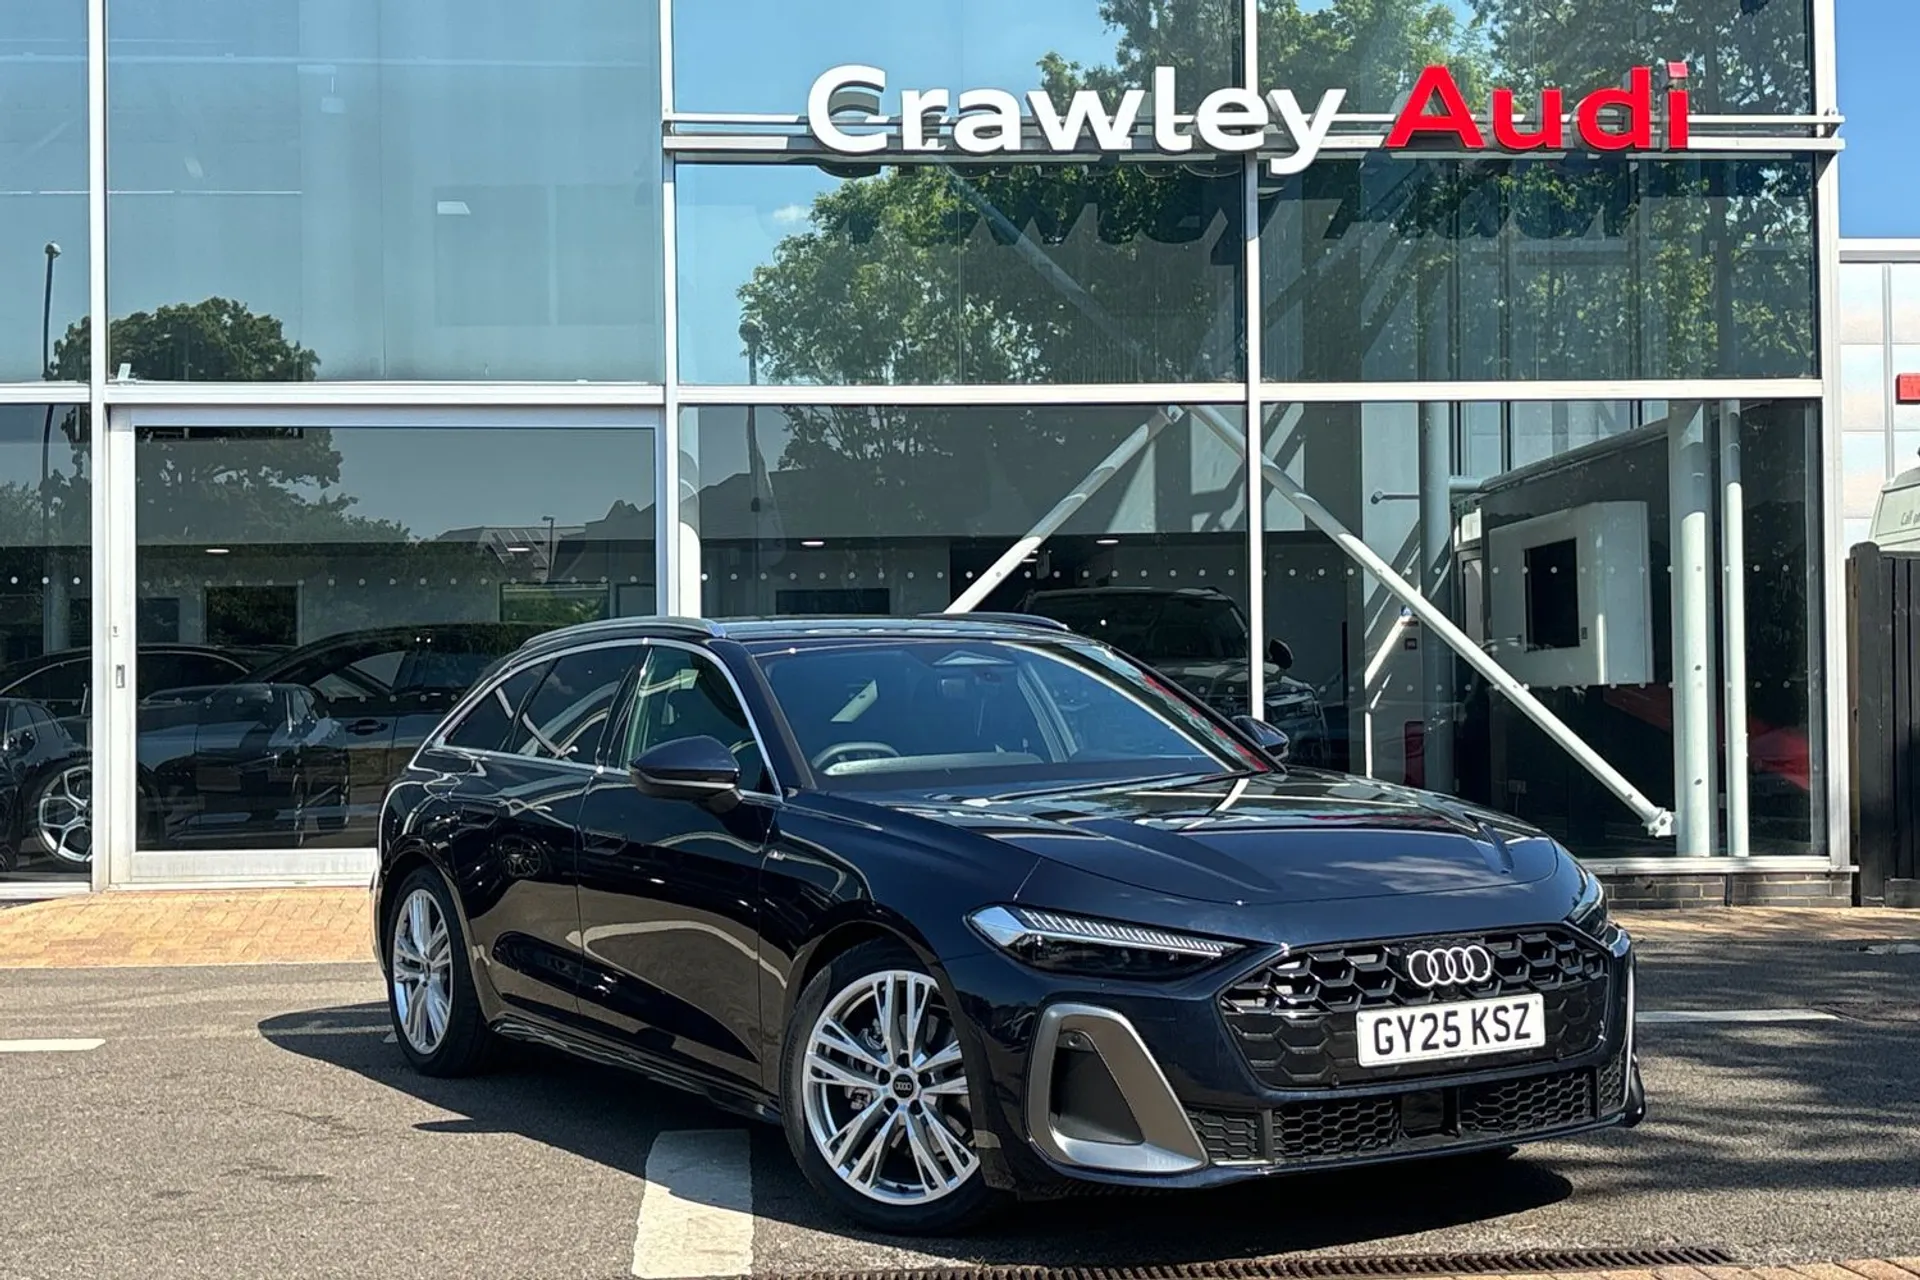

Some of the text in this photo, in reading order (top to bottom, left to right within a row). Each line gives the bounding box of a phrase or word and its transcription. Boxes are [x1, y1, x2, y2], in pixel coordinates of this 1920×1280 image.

[807, 61, 1689, 175] Crawley Audi
[1373, 1002, 1531, 1056] GY25 KSZ
